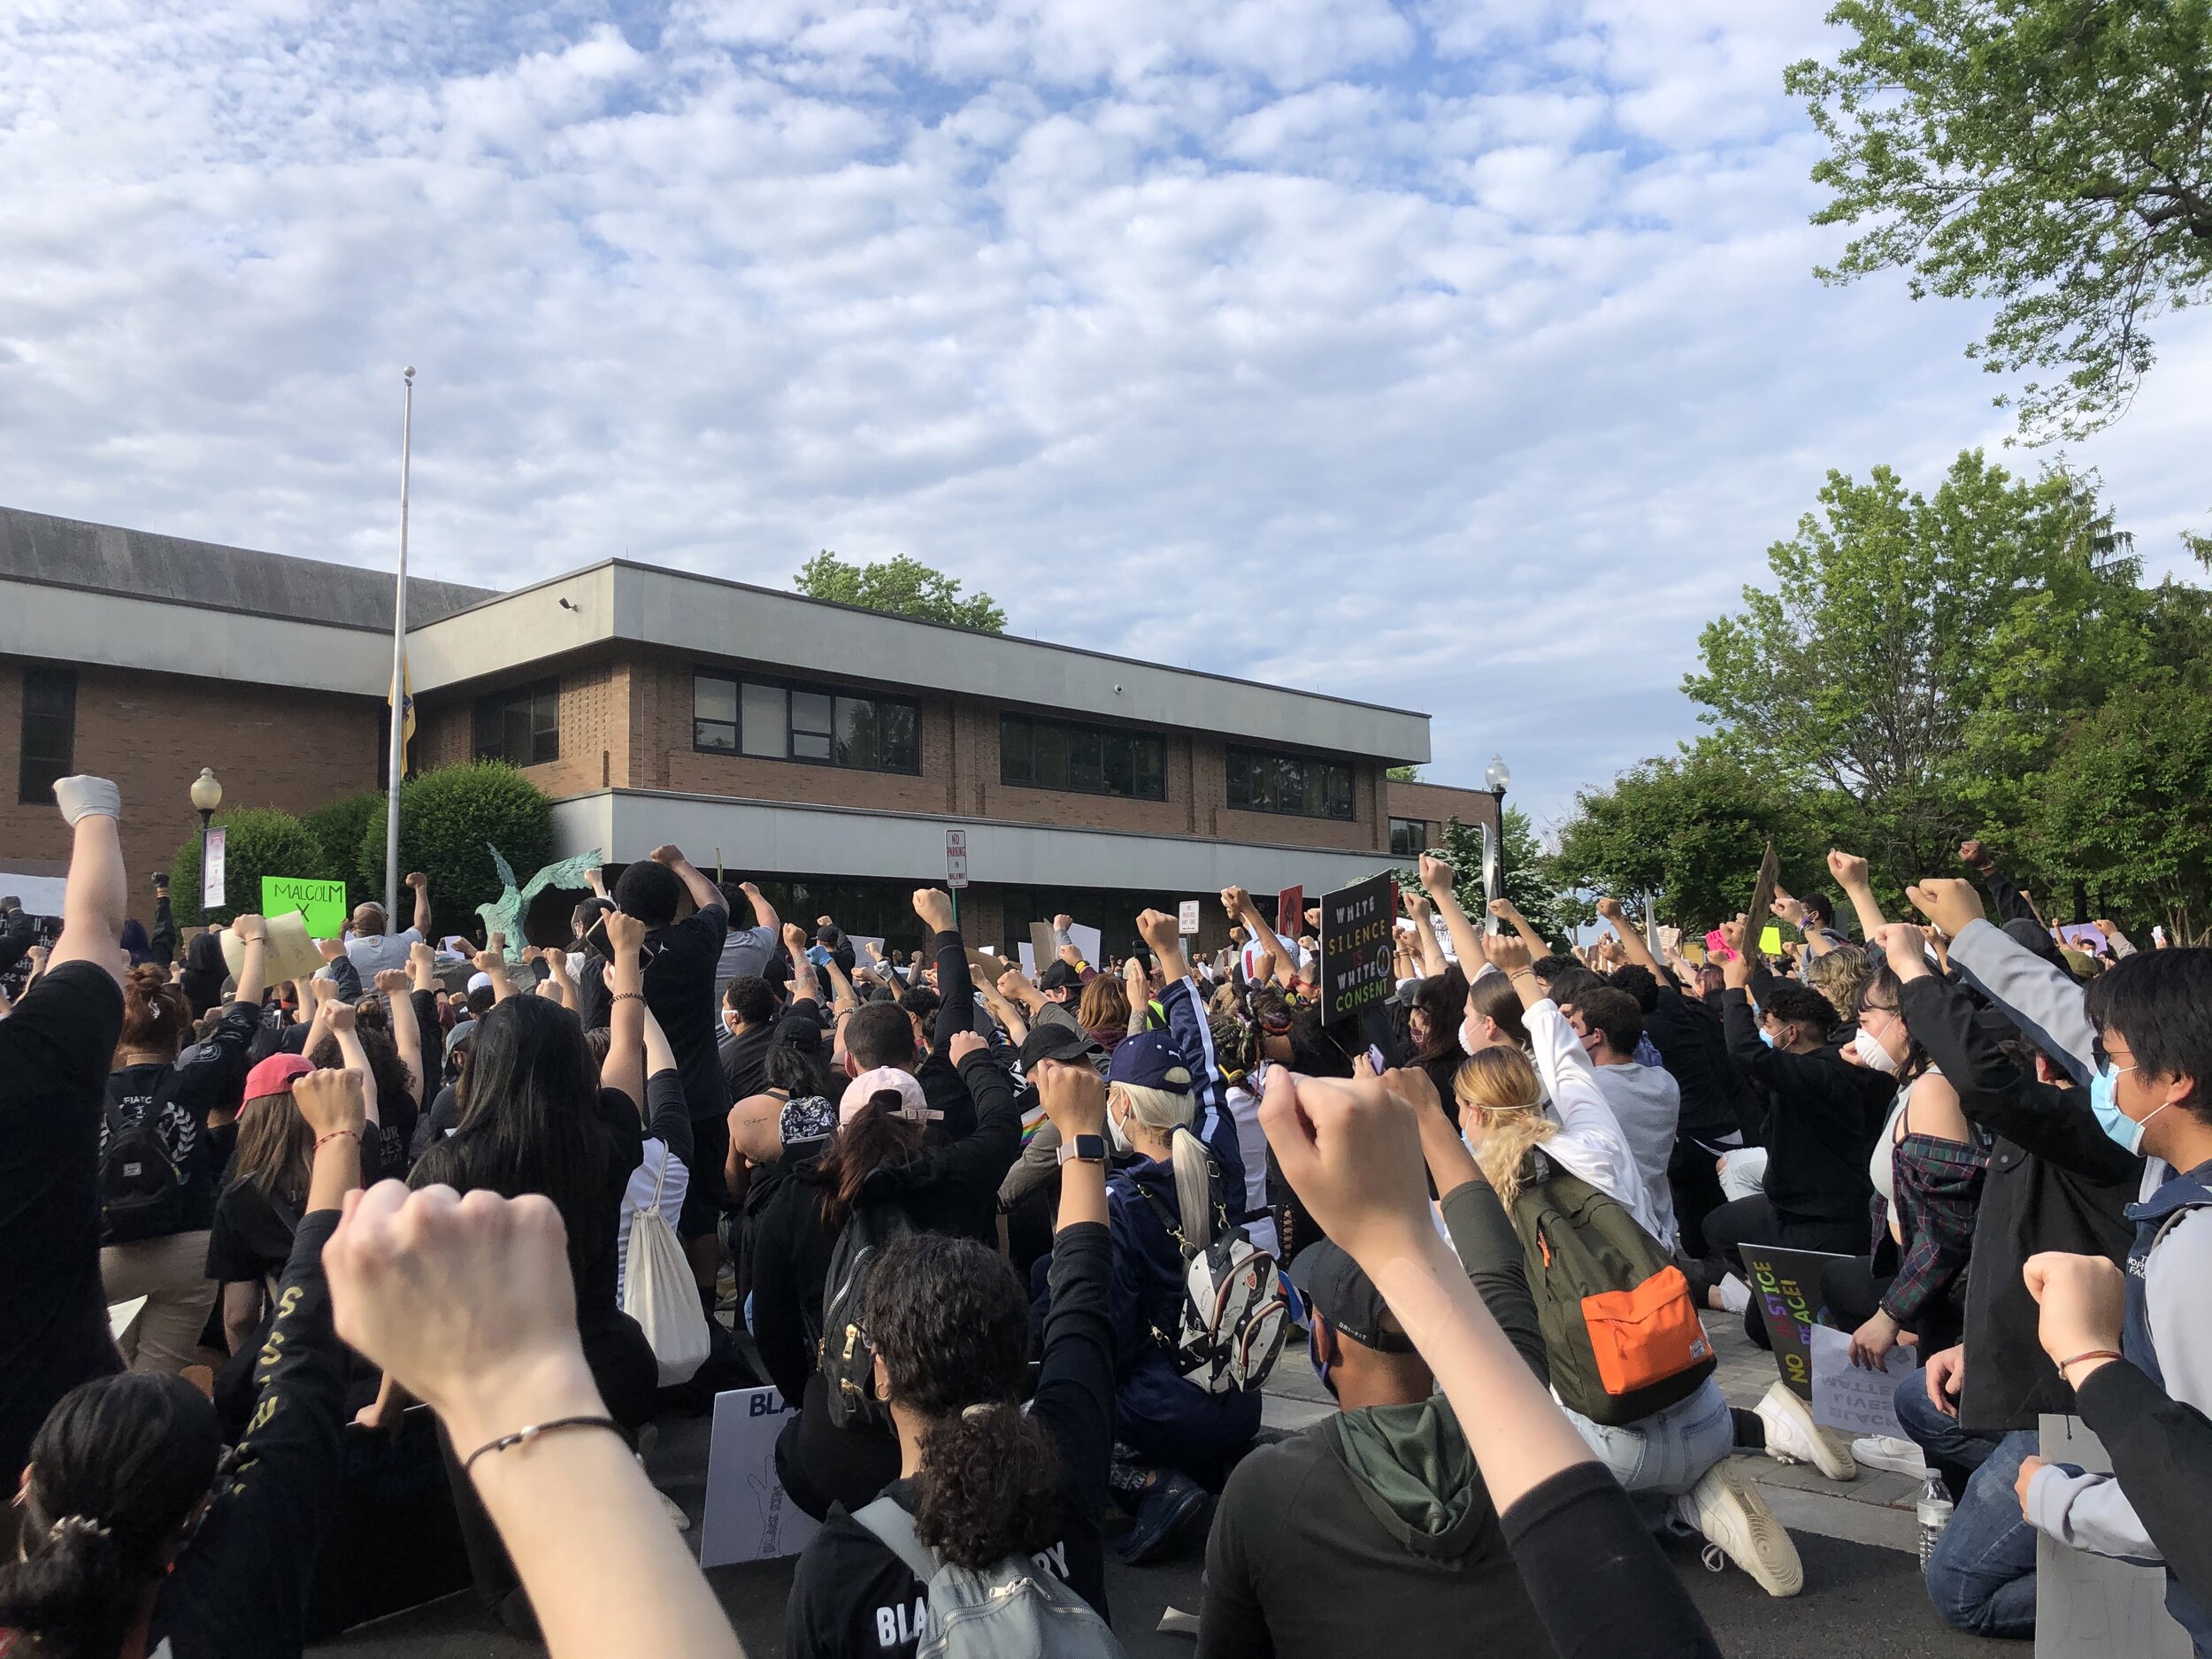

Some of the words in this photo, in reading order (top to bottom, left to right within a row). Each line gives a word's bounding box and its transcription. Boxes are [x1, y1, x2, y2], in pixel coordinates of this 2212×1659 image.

[948, 846, 966, 856] PARKING
[951, 833, 960, 845] NO
[274, 883, 343, 903] MALCOLM
[296, 902, 310, 922] X
[1336, 895, 1375, 925] WHITE
[1329, 919, 1386, 956] SILENCE
[1352, 949, 1364, 968] IS
[1337, 960, 1377, 991] WHITE
[1335, 978, 1388, 1012] CONSENT
[2129, 1265, 2146, 1279] FAC
[1753, 1261, 1796, 1339] JUSTICE
[1338, 1321, 1367, 1340] DRI-FIT
[1785, 1354, 1808, 1383] NO
[749, 1392, 799, 1417] BLA
[877, 1596, 930, 1647] BLA
